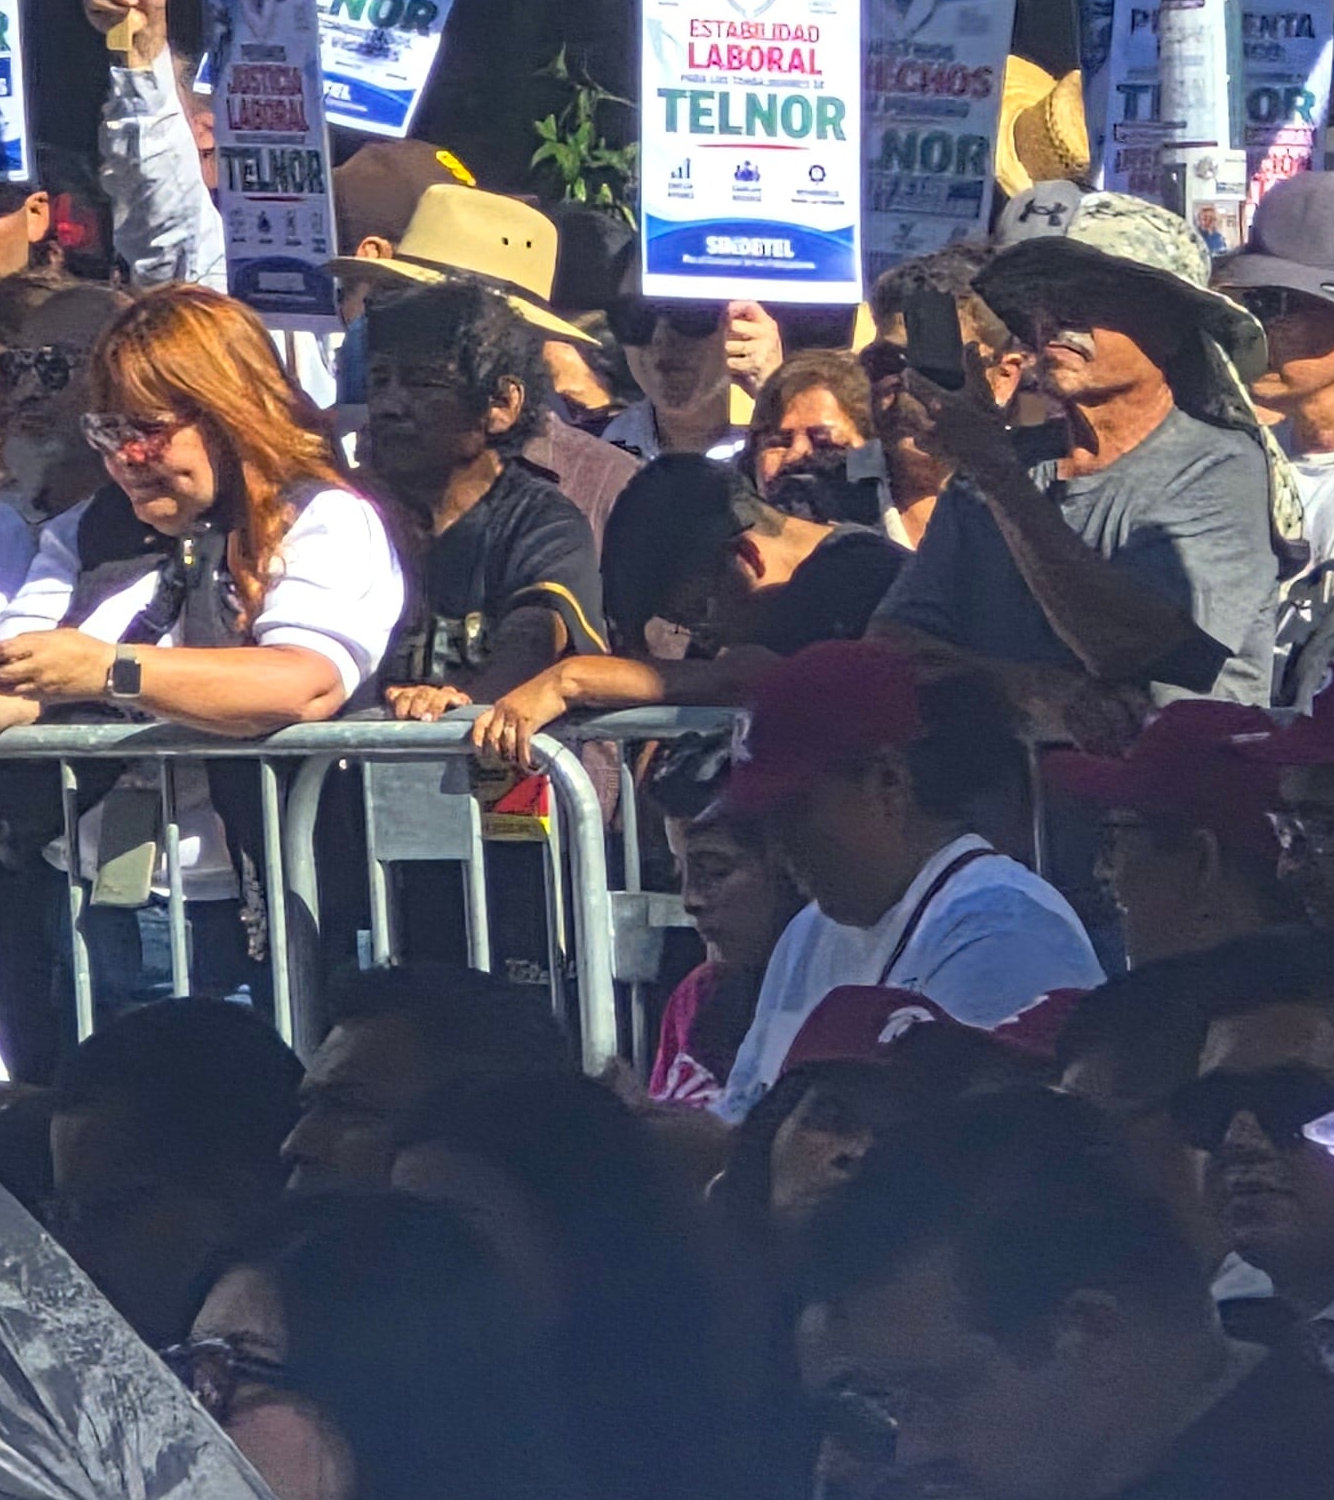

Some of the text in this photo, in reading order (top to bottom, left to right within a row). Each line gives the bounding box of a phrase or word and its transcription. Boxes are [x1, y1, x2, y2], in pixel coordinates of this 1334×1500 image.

[690, 18, 820, 43] ESTABILIDAD
[688, 42, 822, 75] LABORAL
[657, 88, 847, 142] TELNOR
[220, 146, 325, 194] TELNOR
